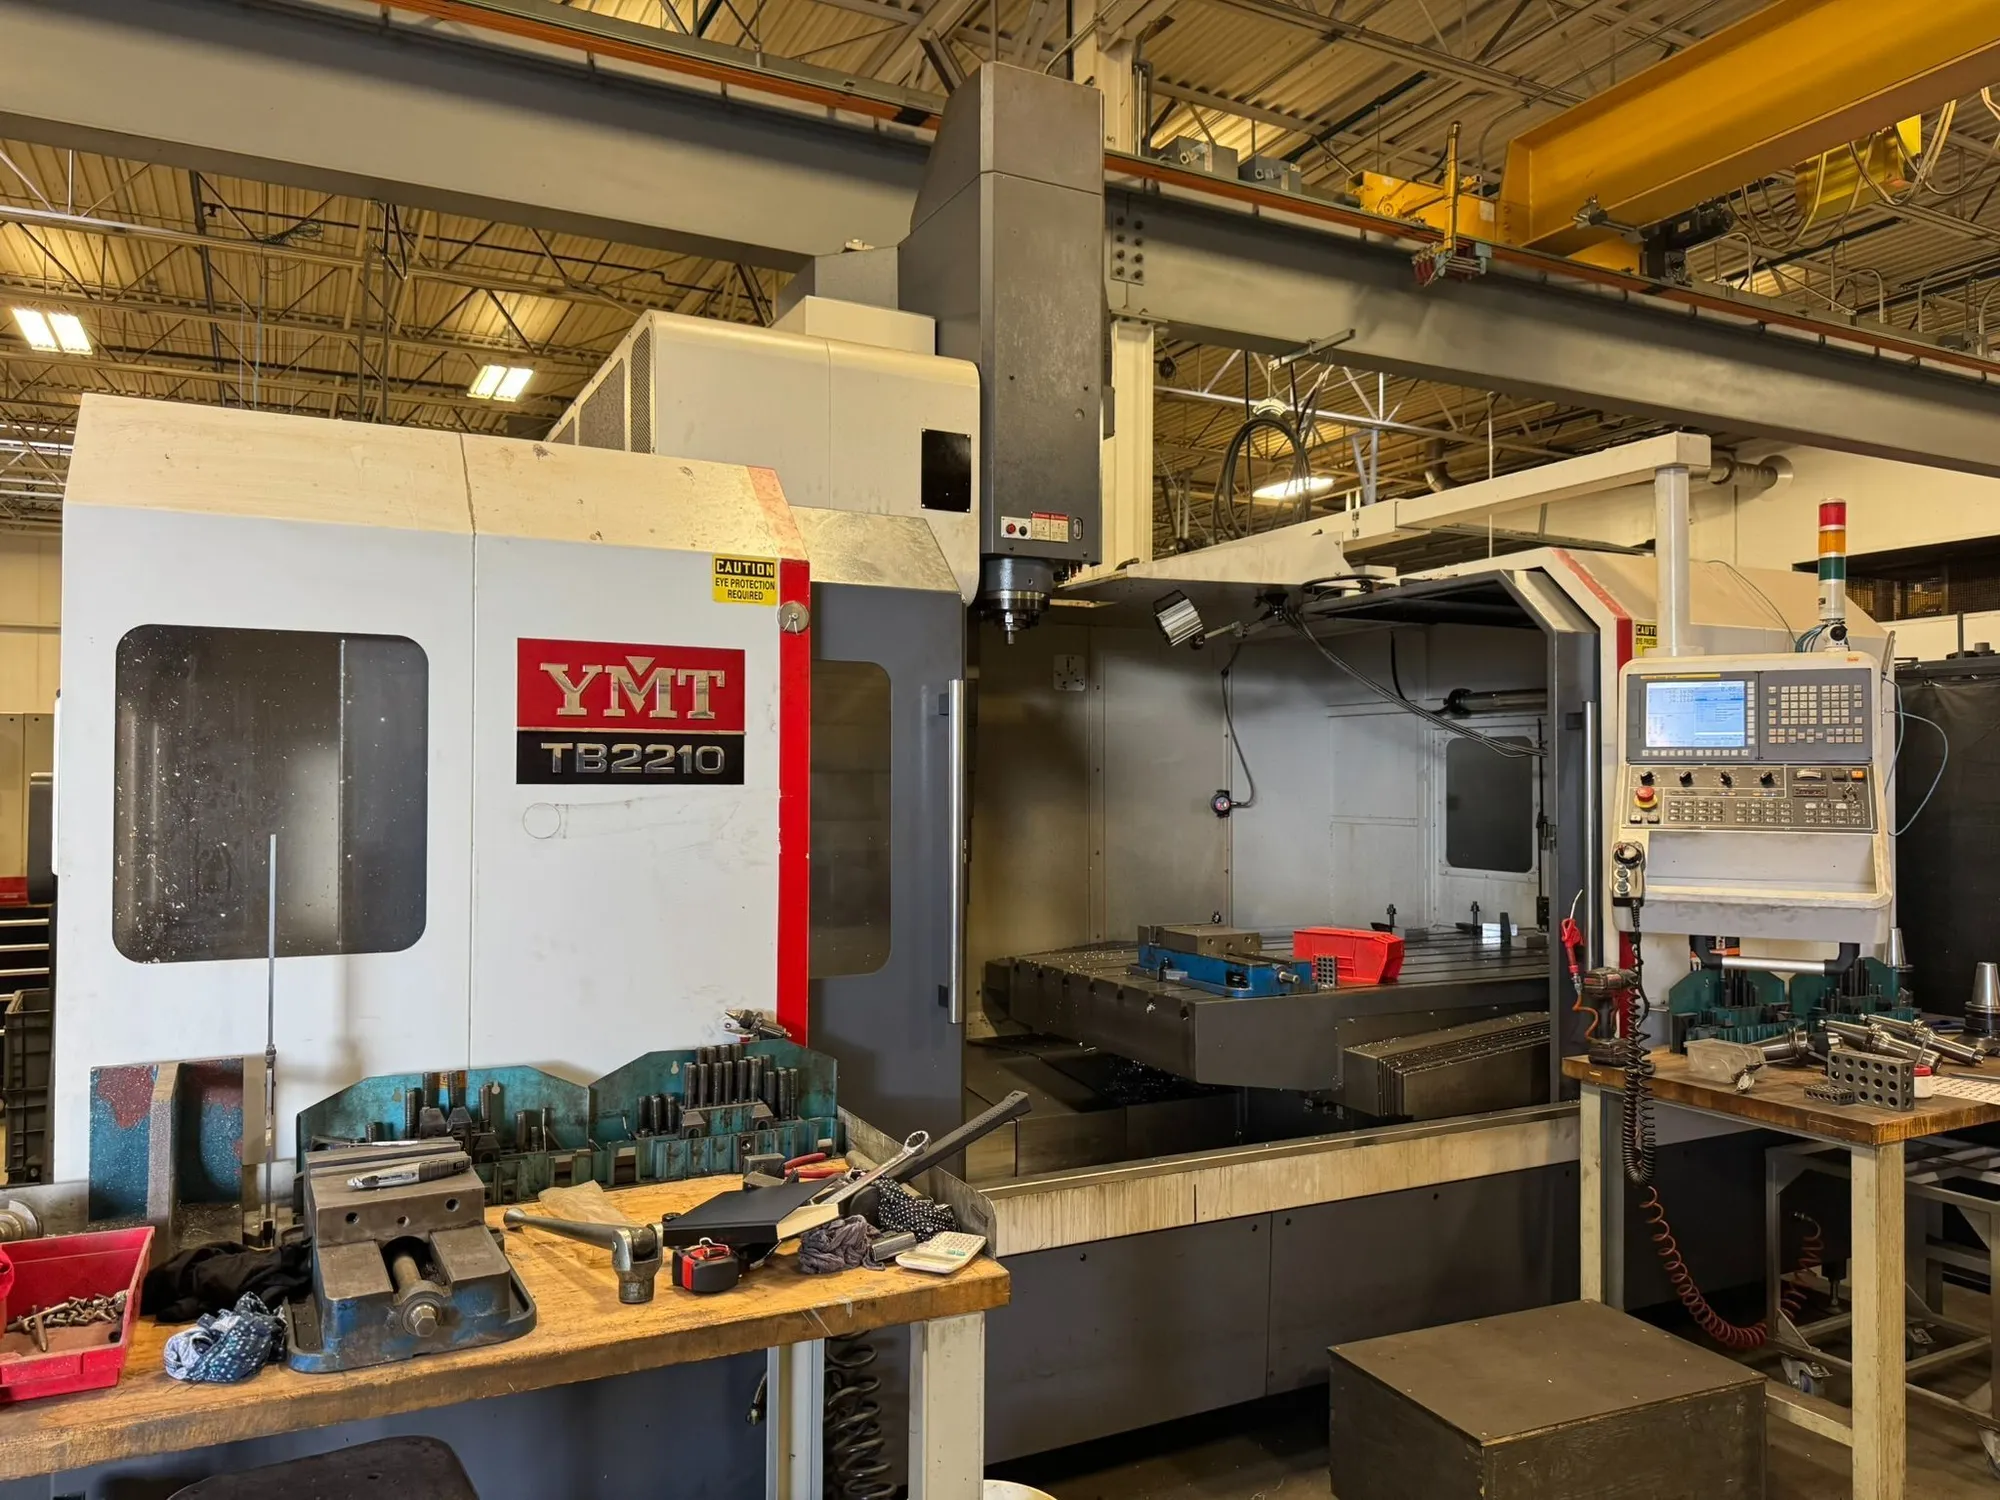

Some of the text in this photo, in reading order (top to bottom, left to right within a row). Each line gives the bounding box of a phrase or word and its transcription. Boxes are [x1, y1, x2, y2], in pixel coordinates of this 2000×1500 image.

[716, 560, 774, 576] CAUTION
[715, 577, 775, 590] EYE PROTECTION
[727, 589, 764, 600] REQUIRED
[1636, 625, 1657, 636] CAUT
[540, 655, 725, 719] YMT
[541, 742, 725, 775] TB2210
